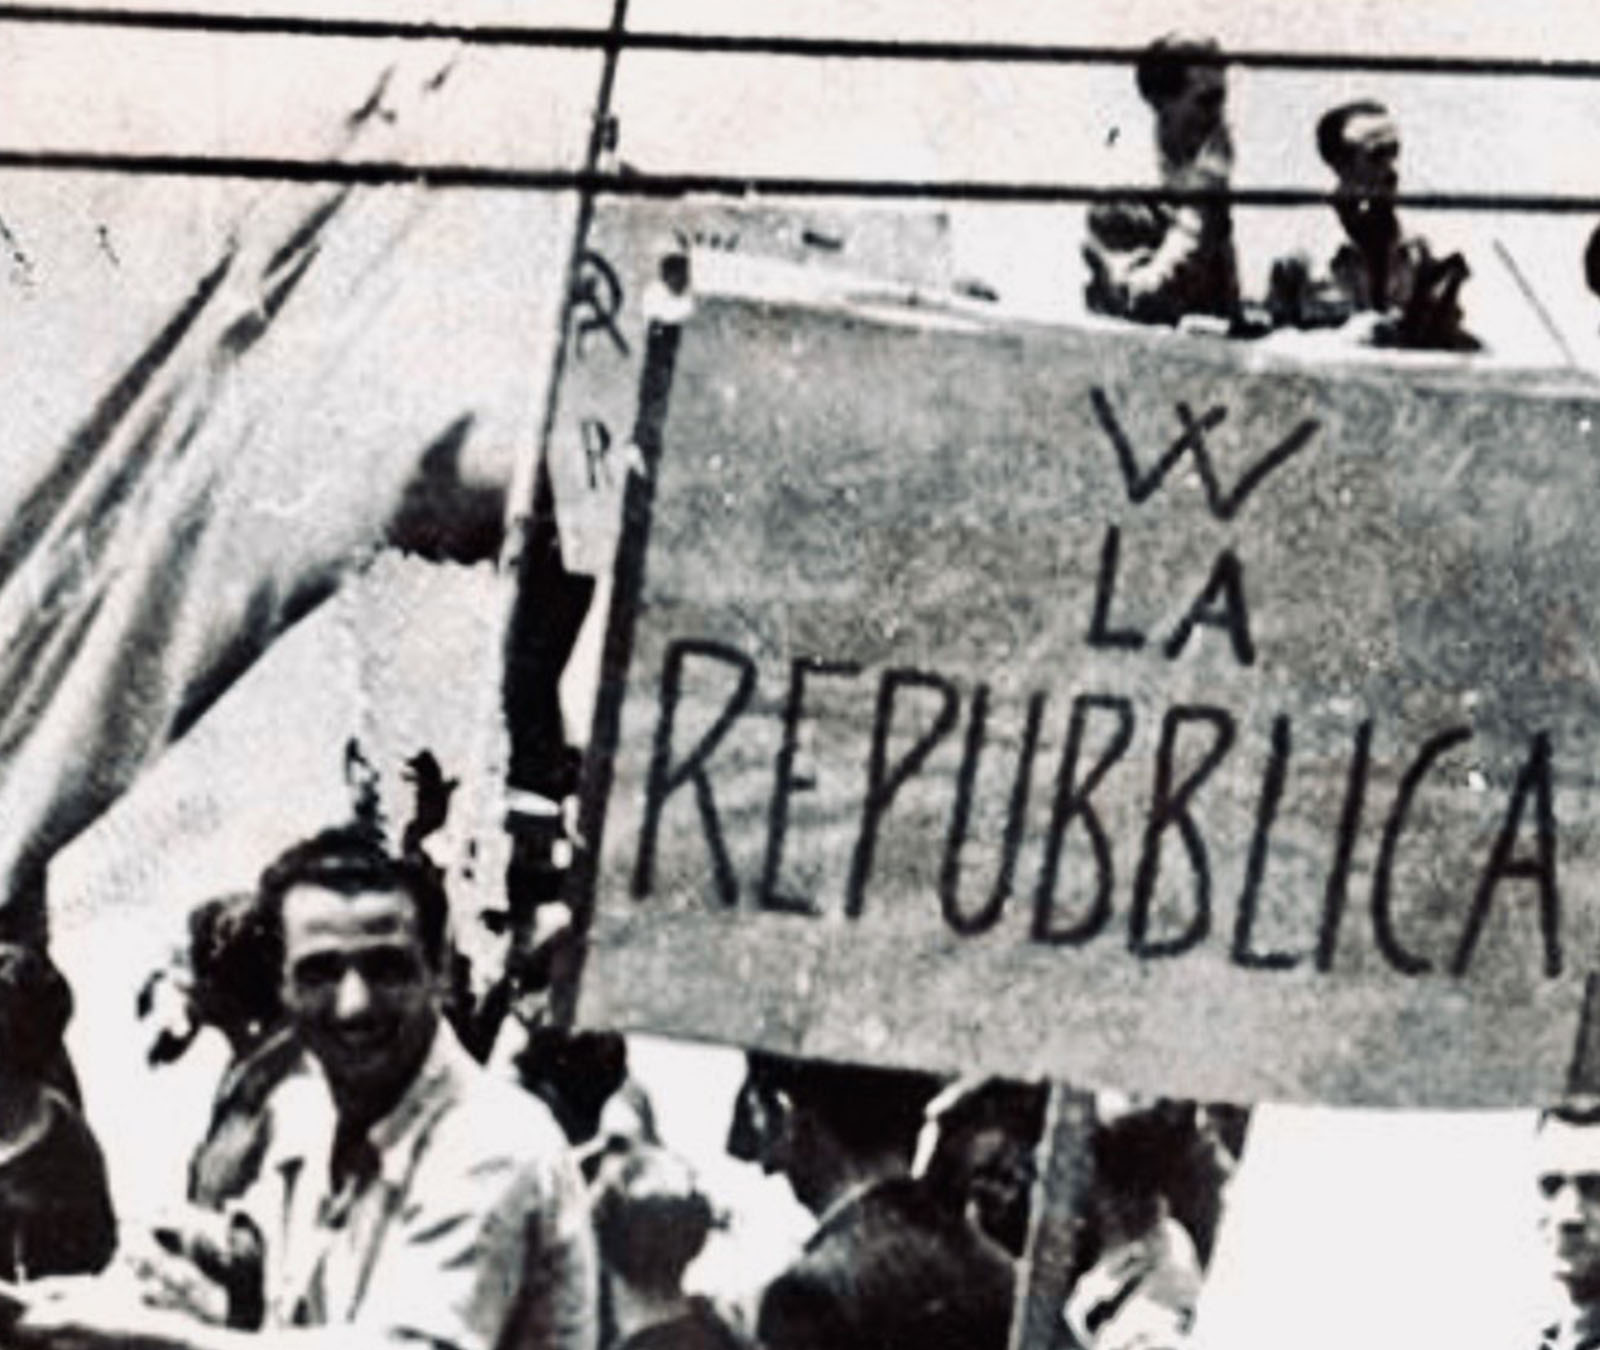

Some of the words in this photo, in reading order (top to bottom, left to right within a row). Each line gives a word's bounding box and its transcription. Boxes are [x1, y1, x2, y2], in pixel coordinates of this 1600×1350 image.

[1090, 385, 1321, 520] W
[1082, 523, 1256, 666] LA
[630, 638, 1564, 980] REPUBBLICA
